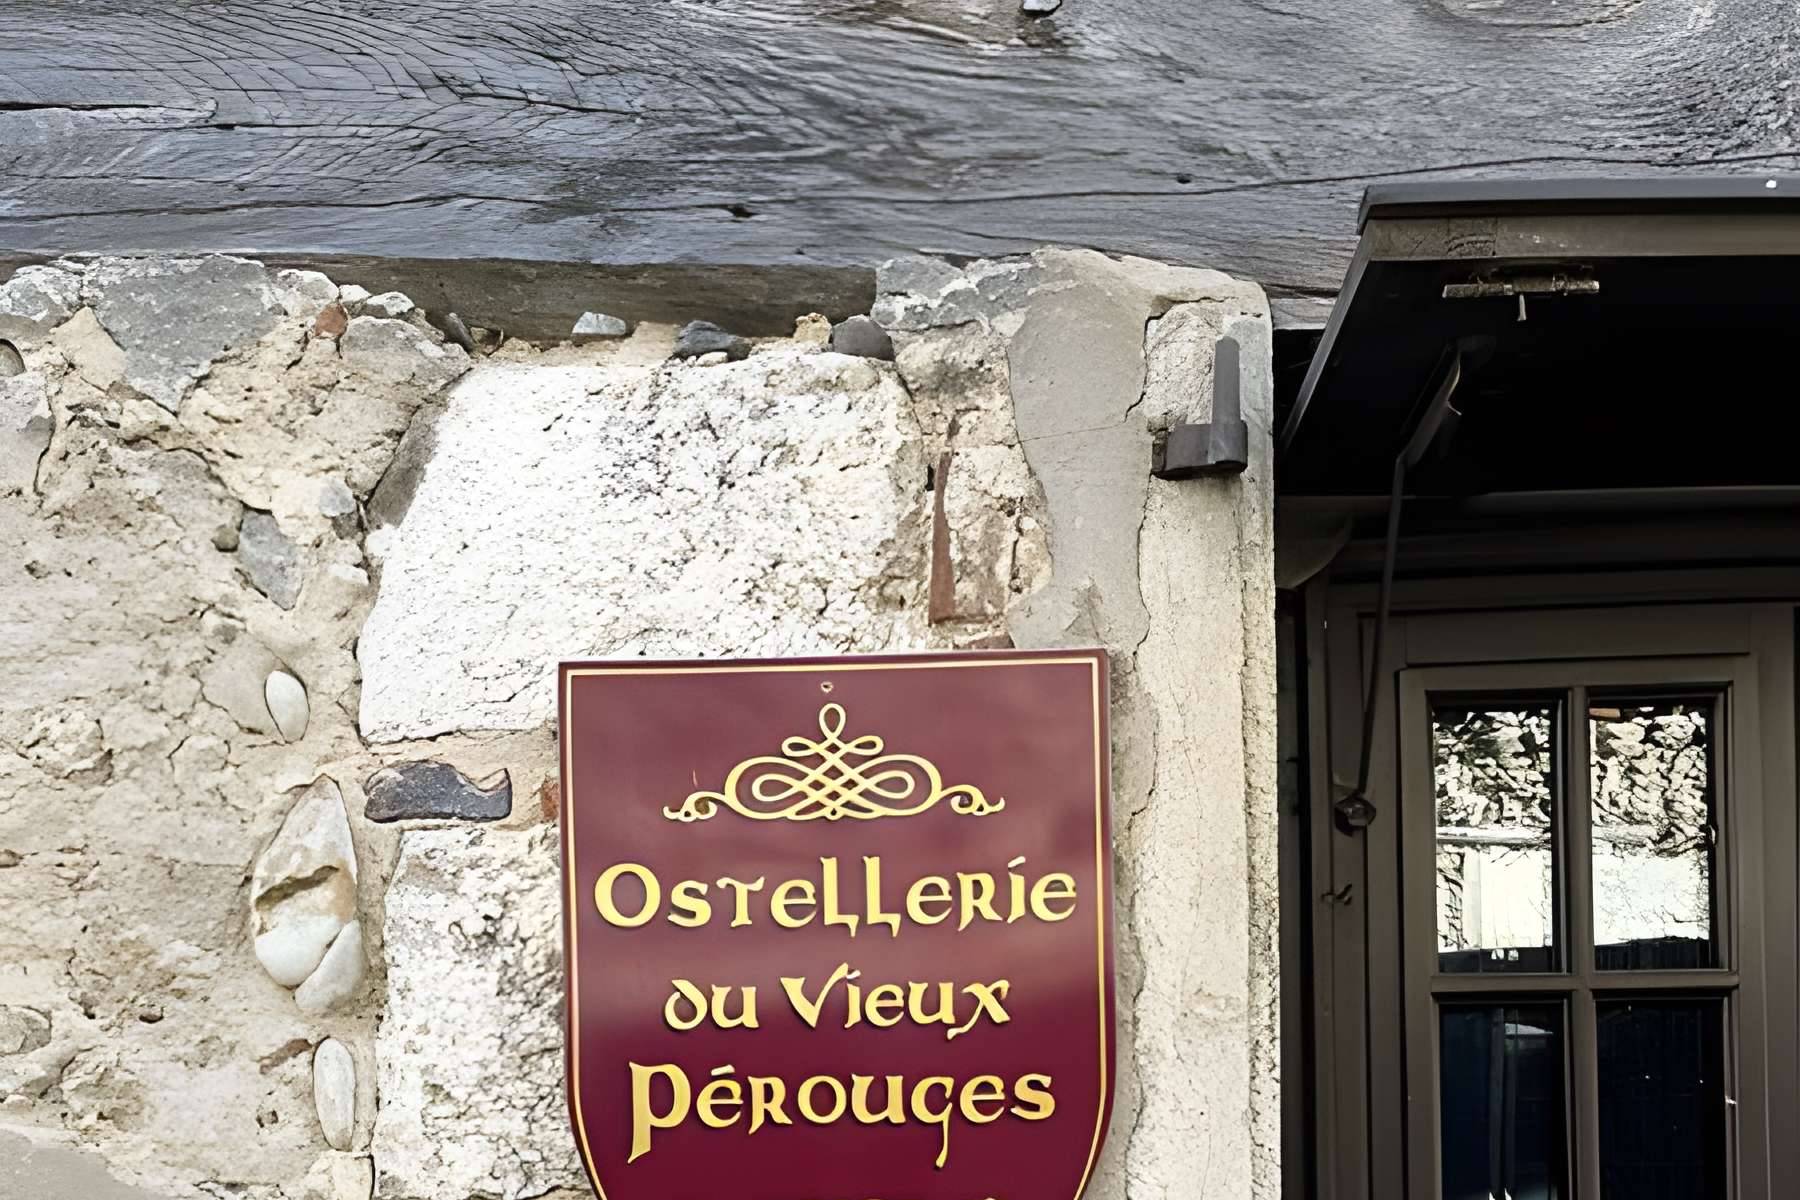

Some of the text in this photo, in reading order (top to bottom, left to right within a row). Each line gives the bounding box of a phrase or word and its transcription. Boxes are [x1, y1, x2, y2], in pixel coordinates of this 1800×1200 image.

[664, 961, 1011, 1040] du Vieux
[627, 1062, 1056, 1168] Pérouges
